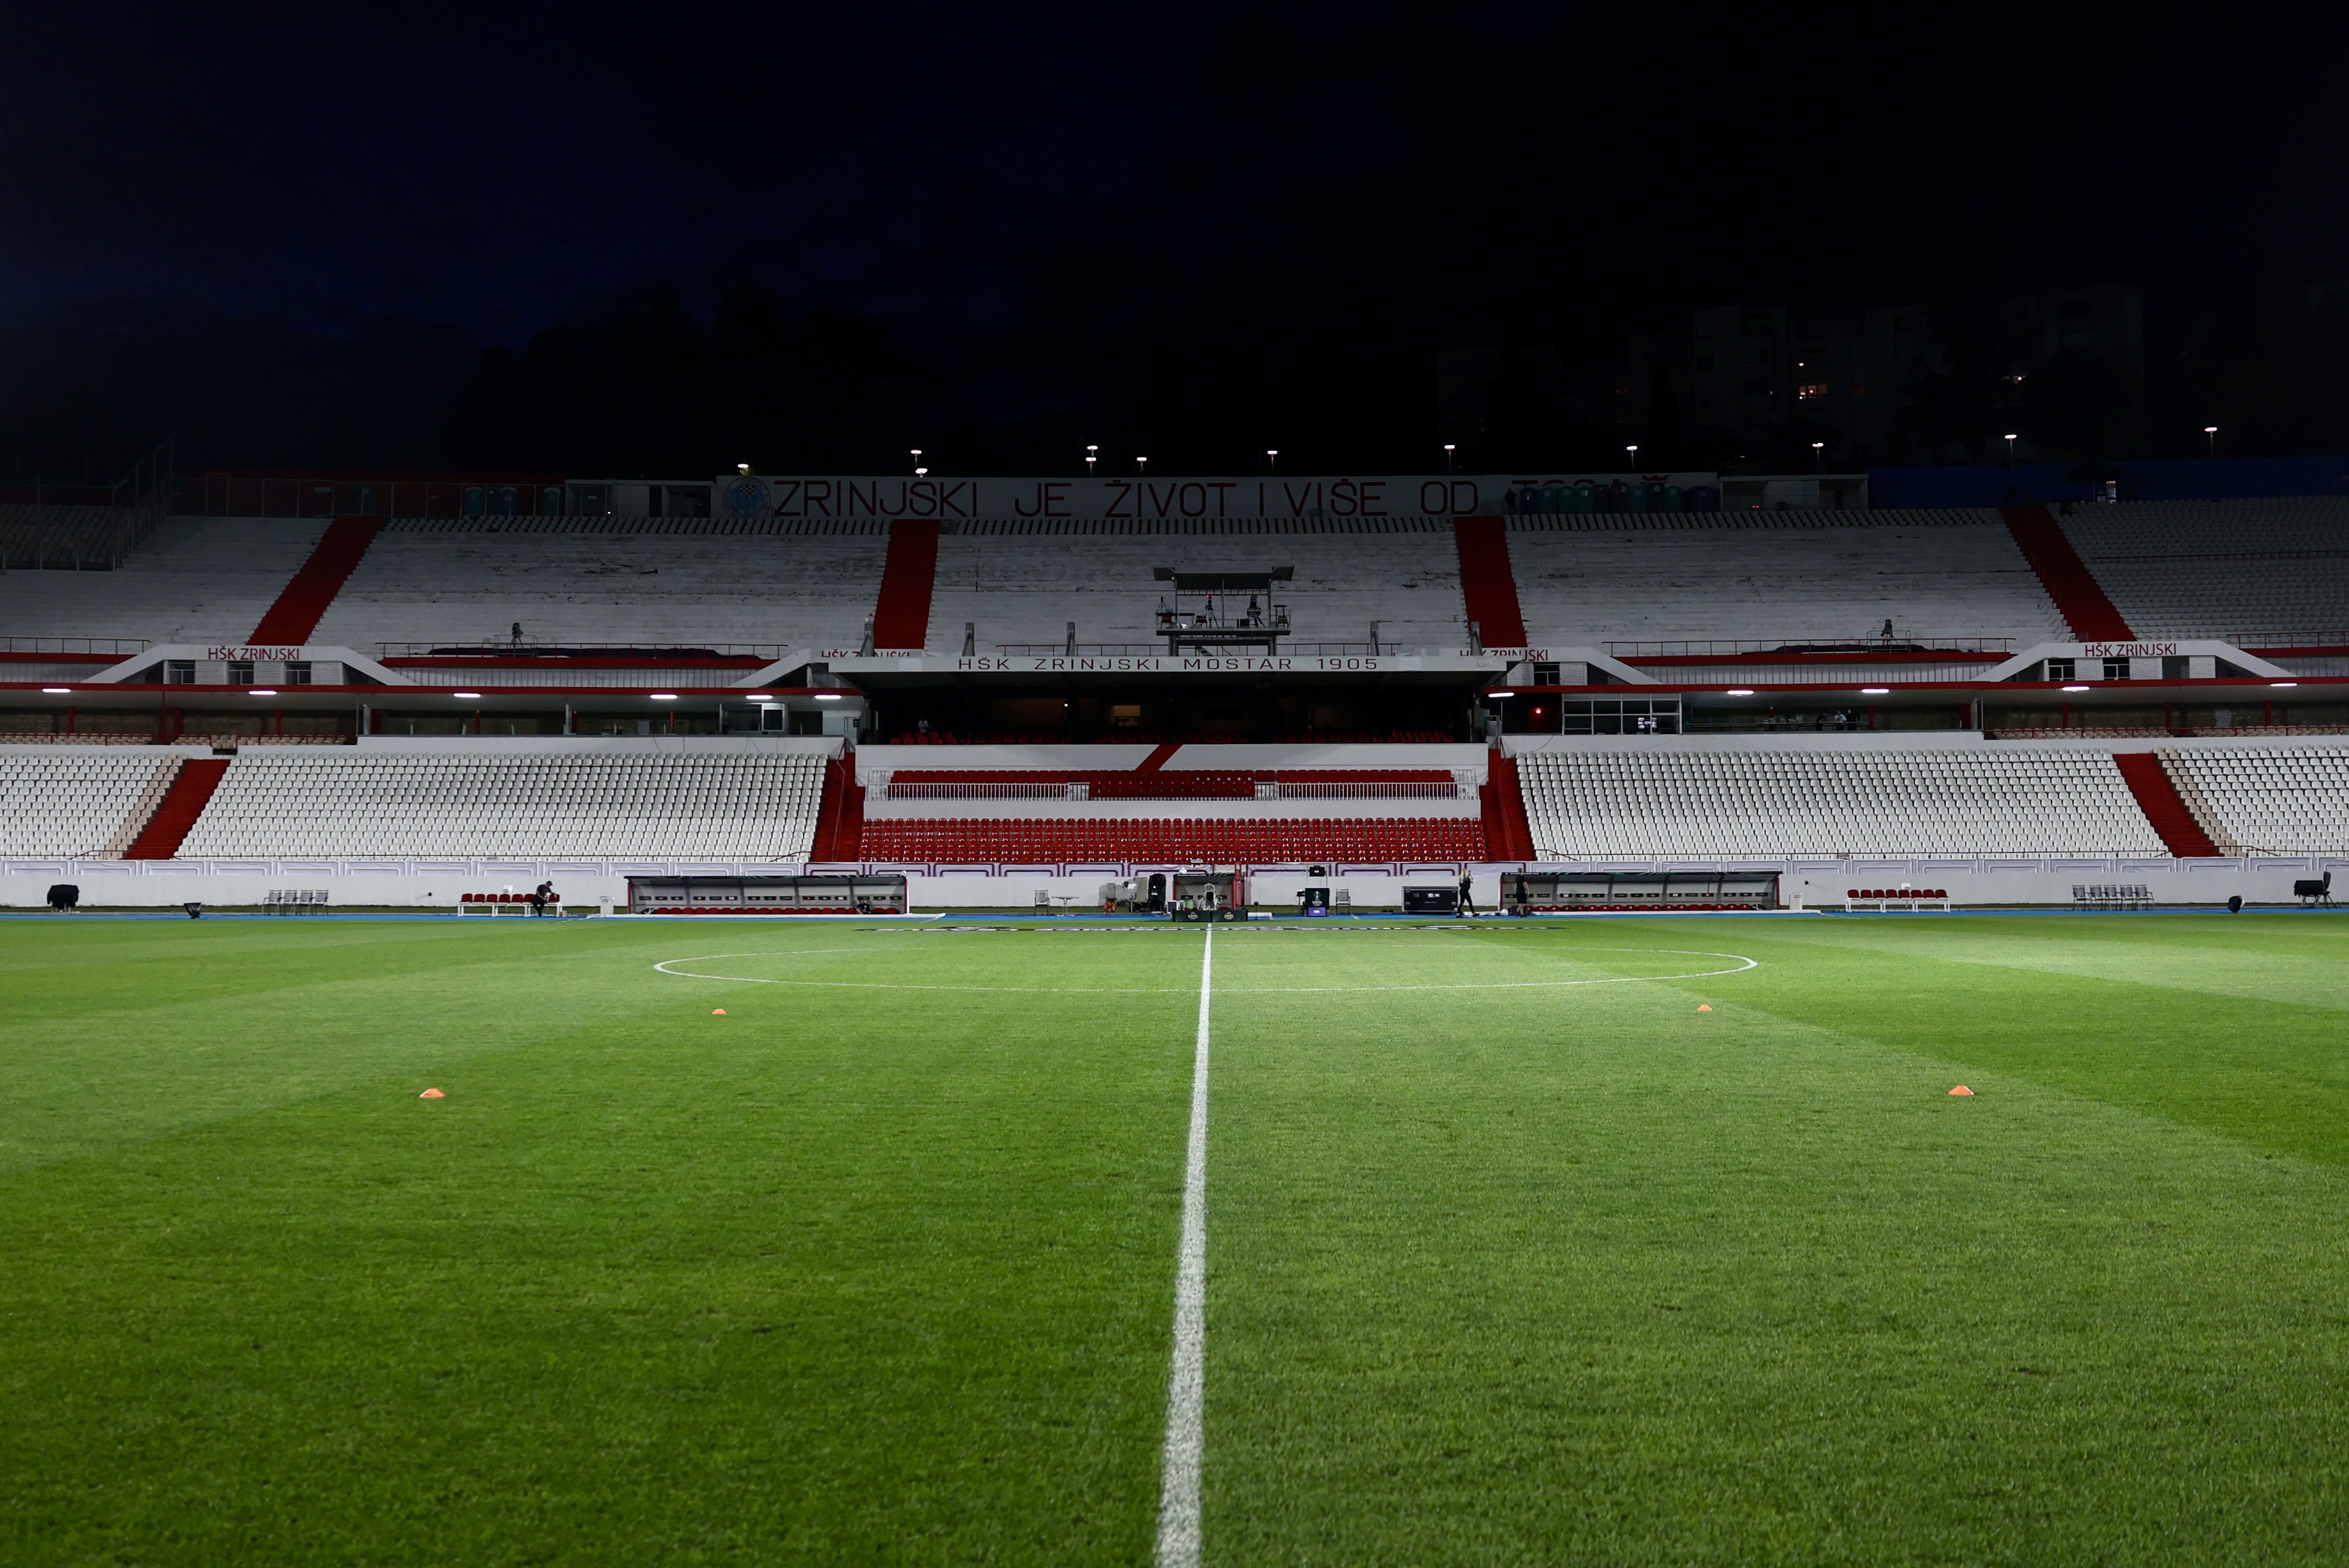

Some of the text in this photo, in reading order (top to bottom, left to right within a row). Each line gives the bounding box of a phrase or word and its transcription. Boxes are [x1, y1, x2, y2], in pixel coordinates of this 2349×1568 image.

[774, 481, 979, 516] ZRINJSKI
[1015, 483, 1071, 516] JE
[1105, 480, 1236, 517] ŽIVOT
[1259, 483, 1264, 516] I
[1284, 479, 1387, 516] VIŠE
[1421, 481, 1478, 515] OD
[208, 645, 299, 660] HŠK ZRINJSKI
[2085, 642, 2176, 657] HŠK ZRINJSKI
[959, 657, 1377, 670] HŠK ZRINJSKI MOSTAR 1905
